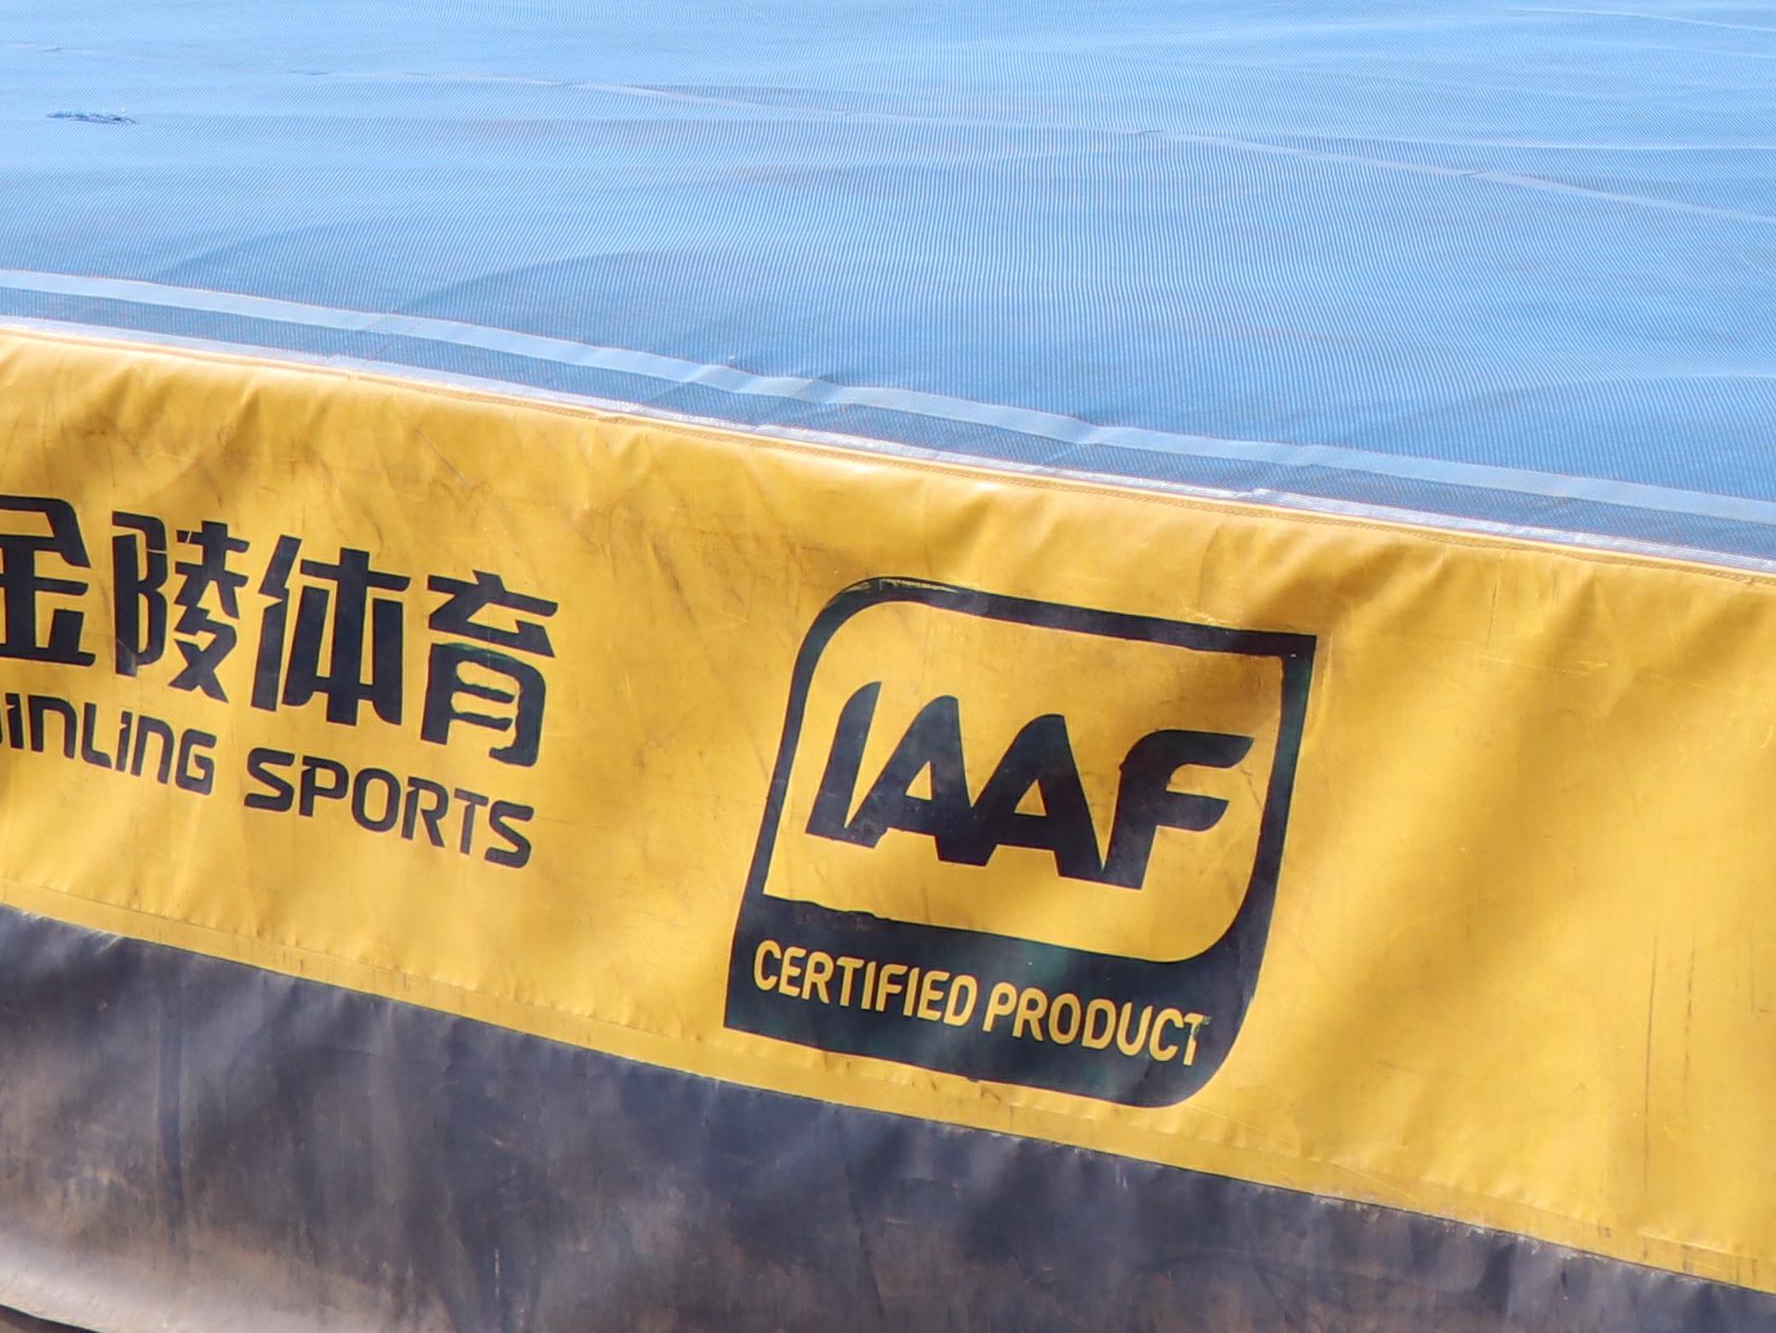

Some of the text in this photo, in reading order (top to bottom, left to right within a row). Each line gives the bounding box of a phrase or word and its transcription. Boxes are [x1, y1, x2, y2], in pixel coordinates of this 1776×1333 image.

[0, 495, 558, 767] 金陵体育
[0, 692, 535, 870] INLING SPORTS
[804, 680, 1255, 891] IAAF
[753, 939, 1209, 1067] CERTIFIED PRODUCT
